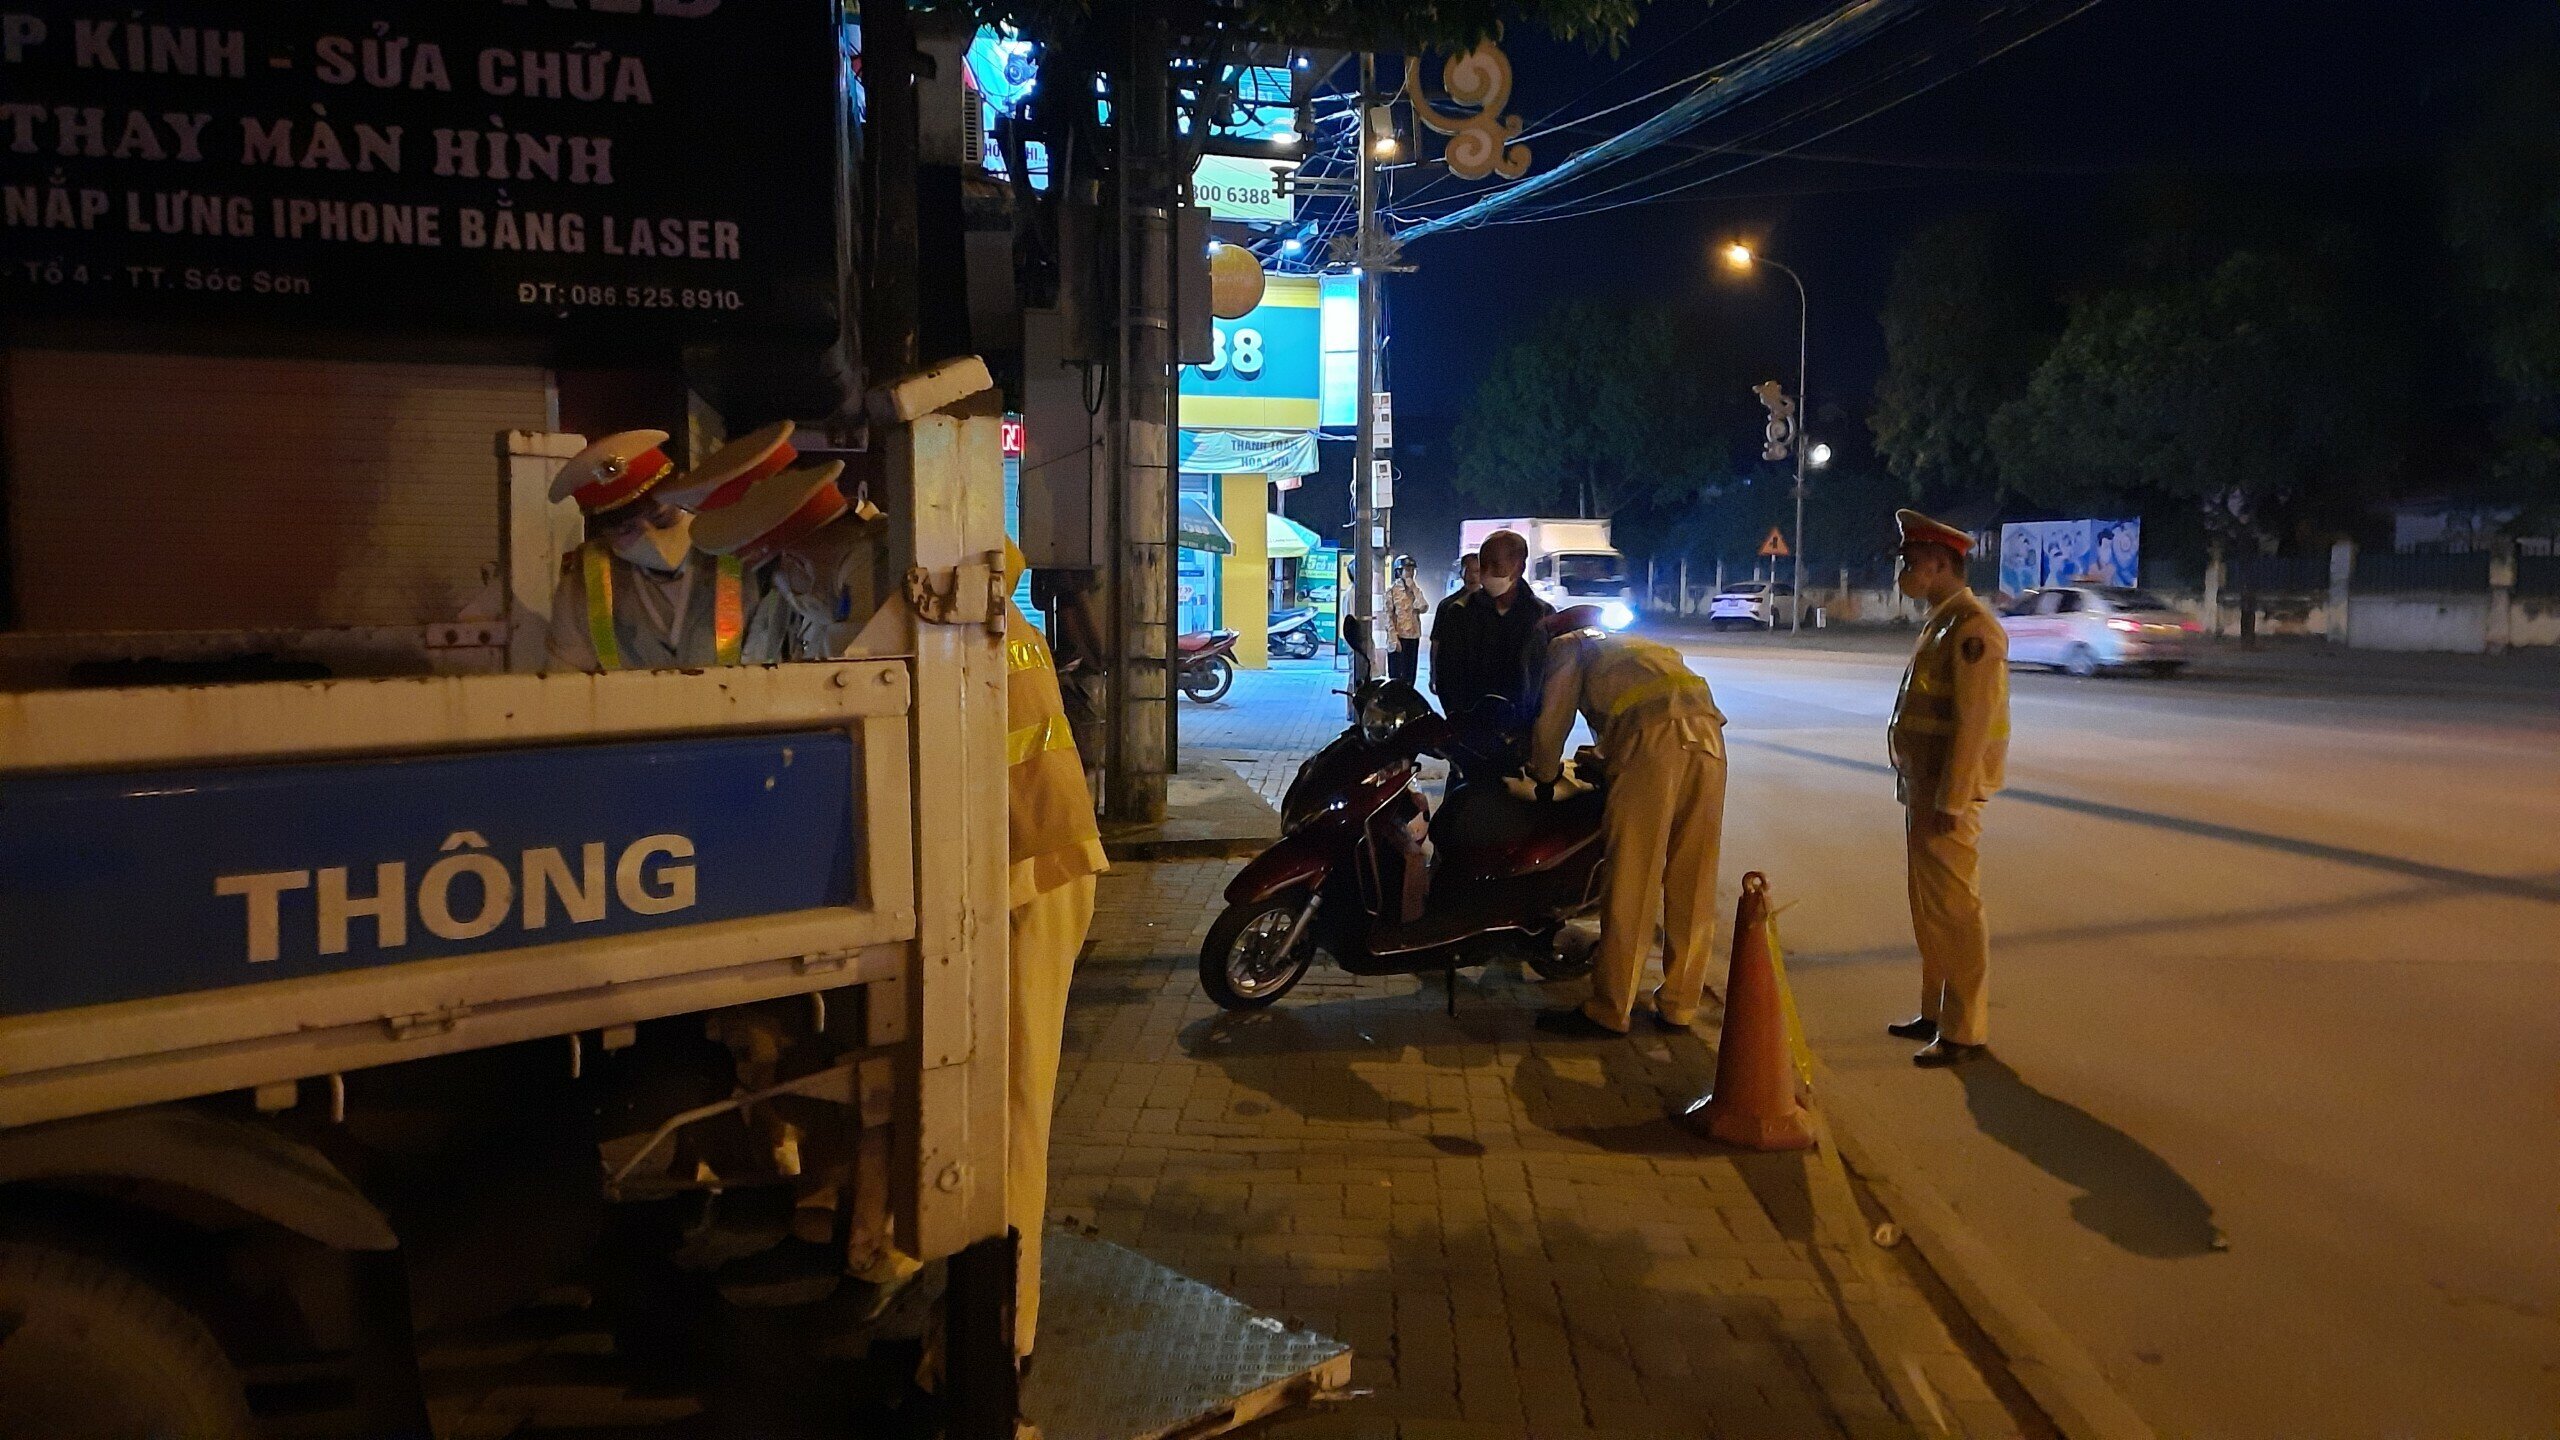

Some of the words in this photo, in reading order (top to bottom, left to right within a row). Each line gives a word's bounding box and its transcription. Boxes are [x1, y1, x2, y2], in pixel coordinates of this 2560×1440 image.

[74, 10, 246, 79] KÍNH
[315, 20, 452, 92] SỬA
[477, 41, 655, 105] CHỮA
[0, 102, 213, 163] THAY
[240, 101, 404, 174] MÀN
[432, 112, 615, 185] HÌNH
[1, 167, 110, 230] NẮP
[126, 189, 255, 238] LƯNG
[271, 198, 441, 247] IPHONE
[459, 186, 586, 254] BẰNG
[602, 214, 742, 261] LASER
[1227, 186, 1271, 205] 6388
[25, 256, 64, 286] Tổ
[72, 265, 90, 286] 4
[126, 265, 176, 290] TT.
[184, 266, 243, 293] Sóc
[251, 270, 312, 295] Sơn
[215, 831, 697, 962] THÔNG
